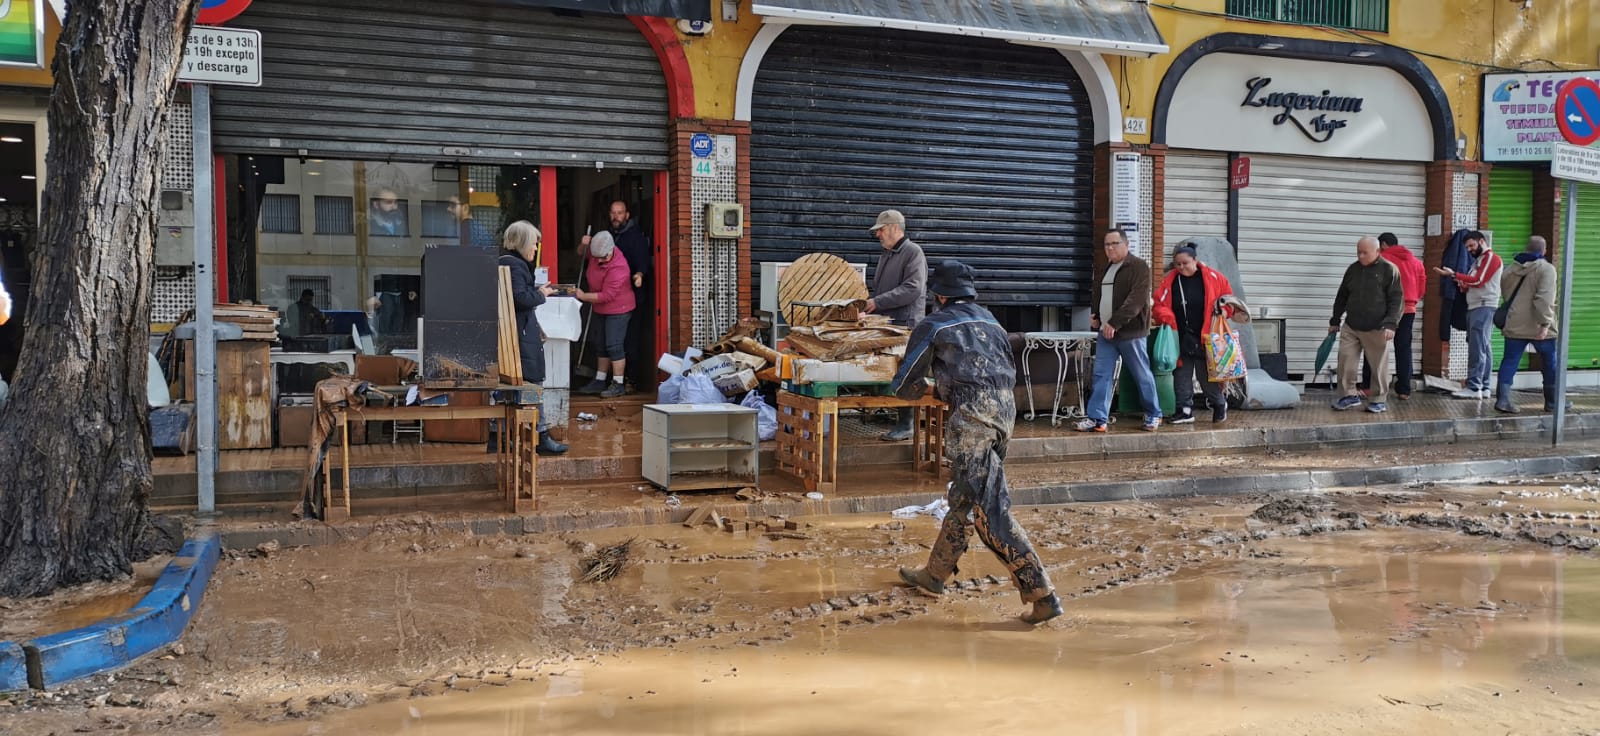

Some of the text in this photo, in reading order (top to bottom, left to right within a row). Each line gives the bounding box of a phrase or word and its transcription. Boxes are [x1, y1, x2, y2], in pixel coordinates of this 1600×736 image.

[202, 34, 214, 45] de
[217, 35, 223, 46] 9
[227, 39, 232, 47] a
[236, 37, 257, 48] 13h.
[185, 46, 254, 61] a 19h excepto
[187, 61, 248, 75] y descarga
[1506, 119, 1557, 129] SEMILL
[695, 140, 709, 149] ADT
[1511, 147, 1522, 155] 951
[1525, 147, 1533, 155] 10
[696, 161, 711, 174] 44
